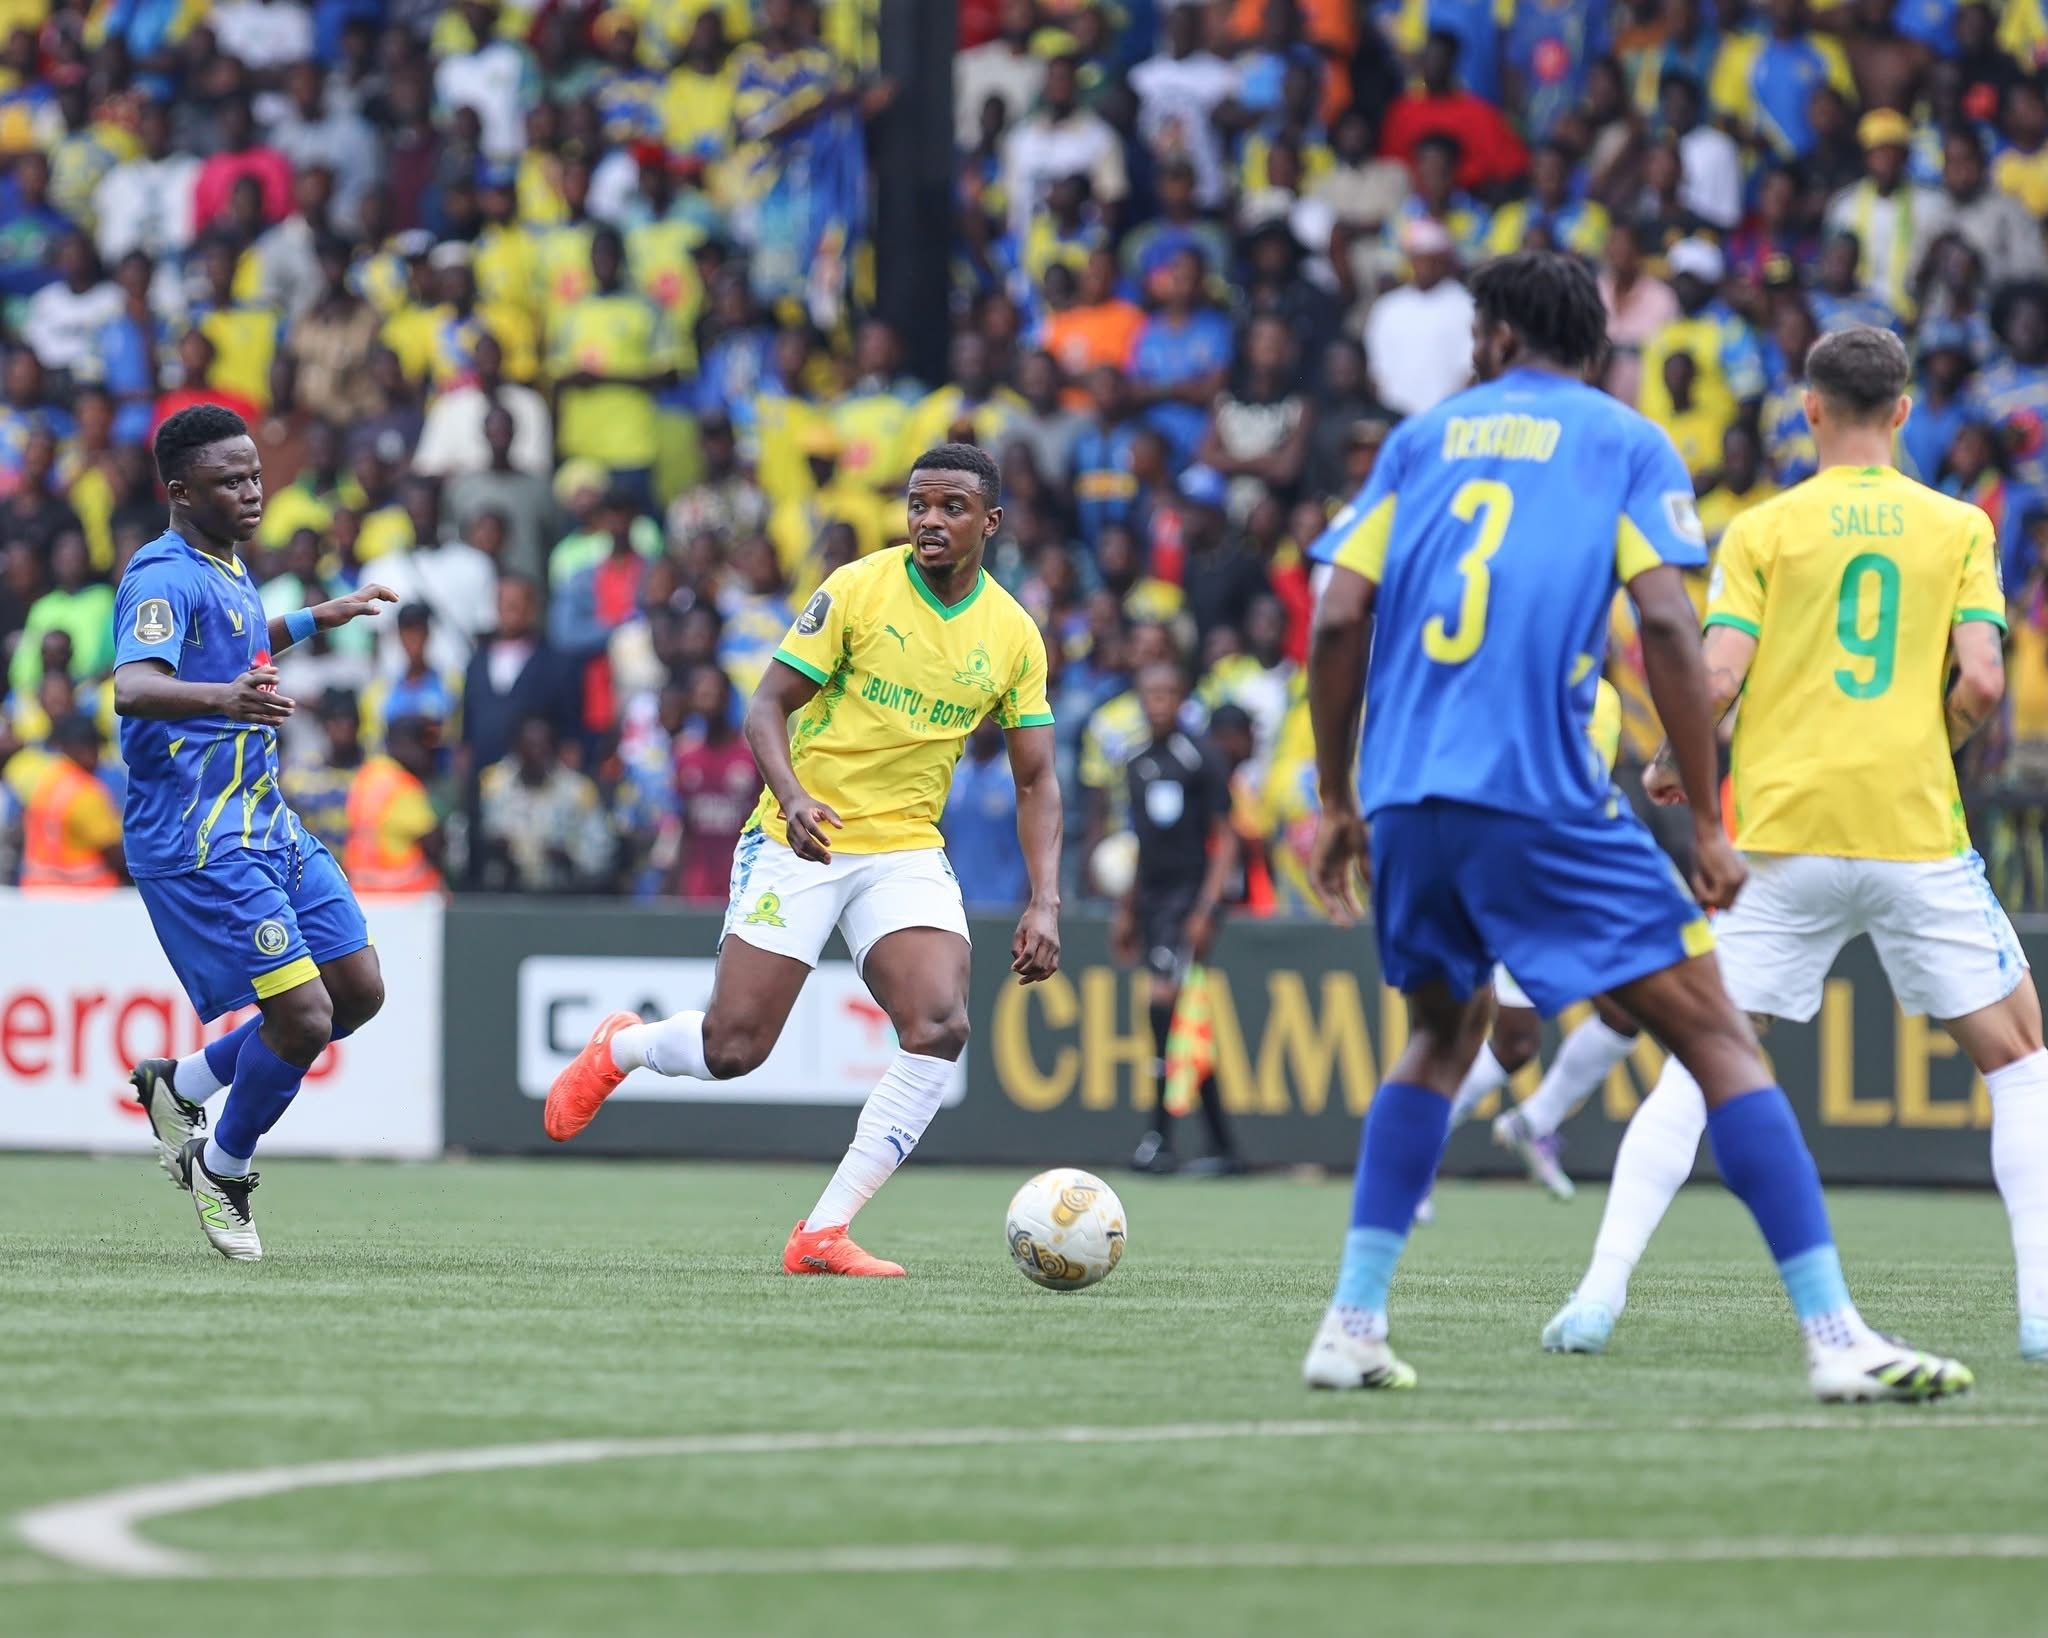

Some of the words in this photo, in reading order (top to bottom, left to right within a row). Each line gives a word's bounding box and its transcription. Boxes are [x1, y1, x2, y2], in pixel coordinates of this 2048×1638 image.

[1422, 479, 1514, 665] 3
[1830, 503, 1905, 537] SALES
[1834, 551, 1901, 700] 9
